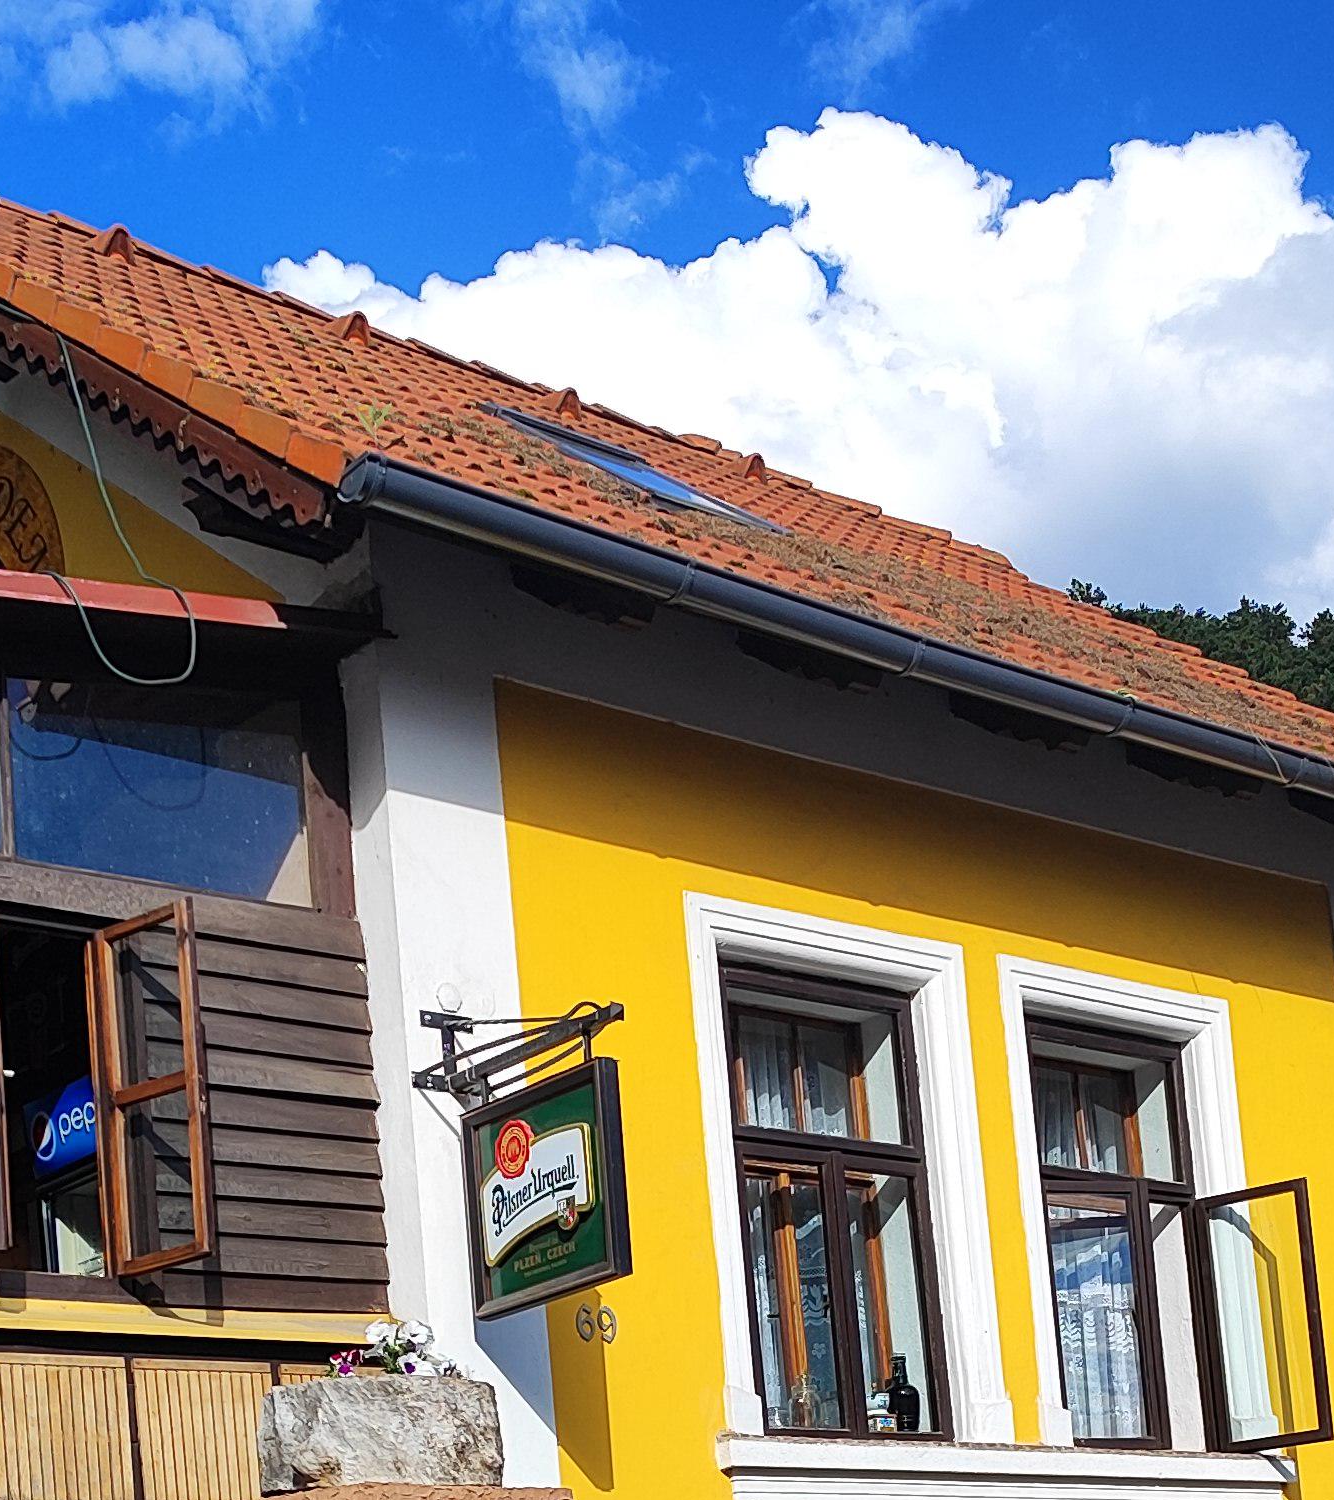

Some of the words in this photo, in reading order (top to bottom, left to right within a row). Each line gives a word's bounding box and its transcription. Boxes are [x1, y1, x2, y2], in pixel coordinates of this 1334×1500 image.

[58, 1101, 96, 1144] pep
[492, 1182, 532, 1237] Pilsner
[530, 1154, 576, 1200] Urquell
[576, 1303, 617, 1344] 69
